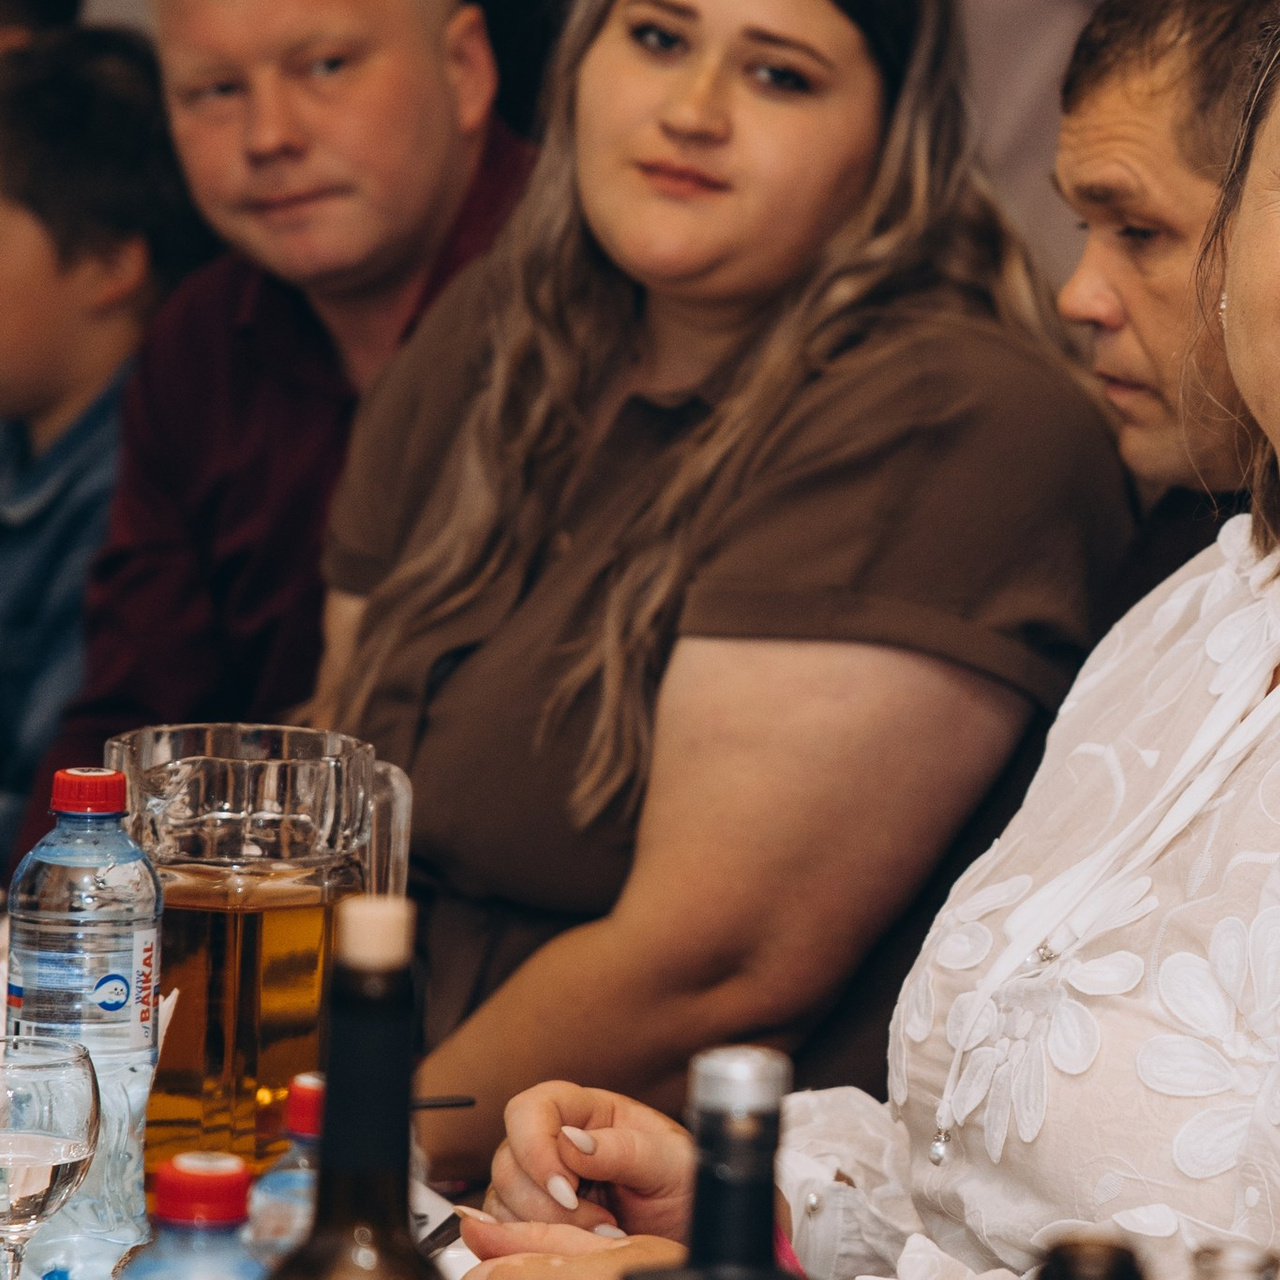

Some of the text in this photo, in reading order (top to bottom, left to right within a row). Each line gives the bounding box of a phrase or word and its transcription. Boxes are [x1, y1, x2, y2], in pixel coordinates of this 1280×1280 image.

[134, 969, 146, 1005] wave
[139, 941, 154, 1038] of BAIKAL
